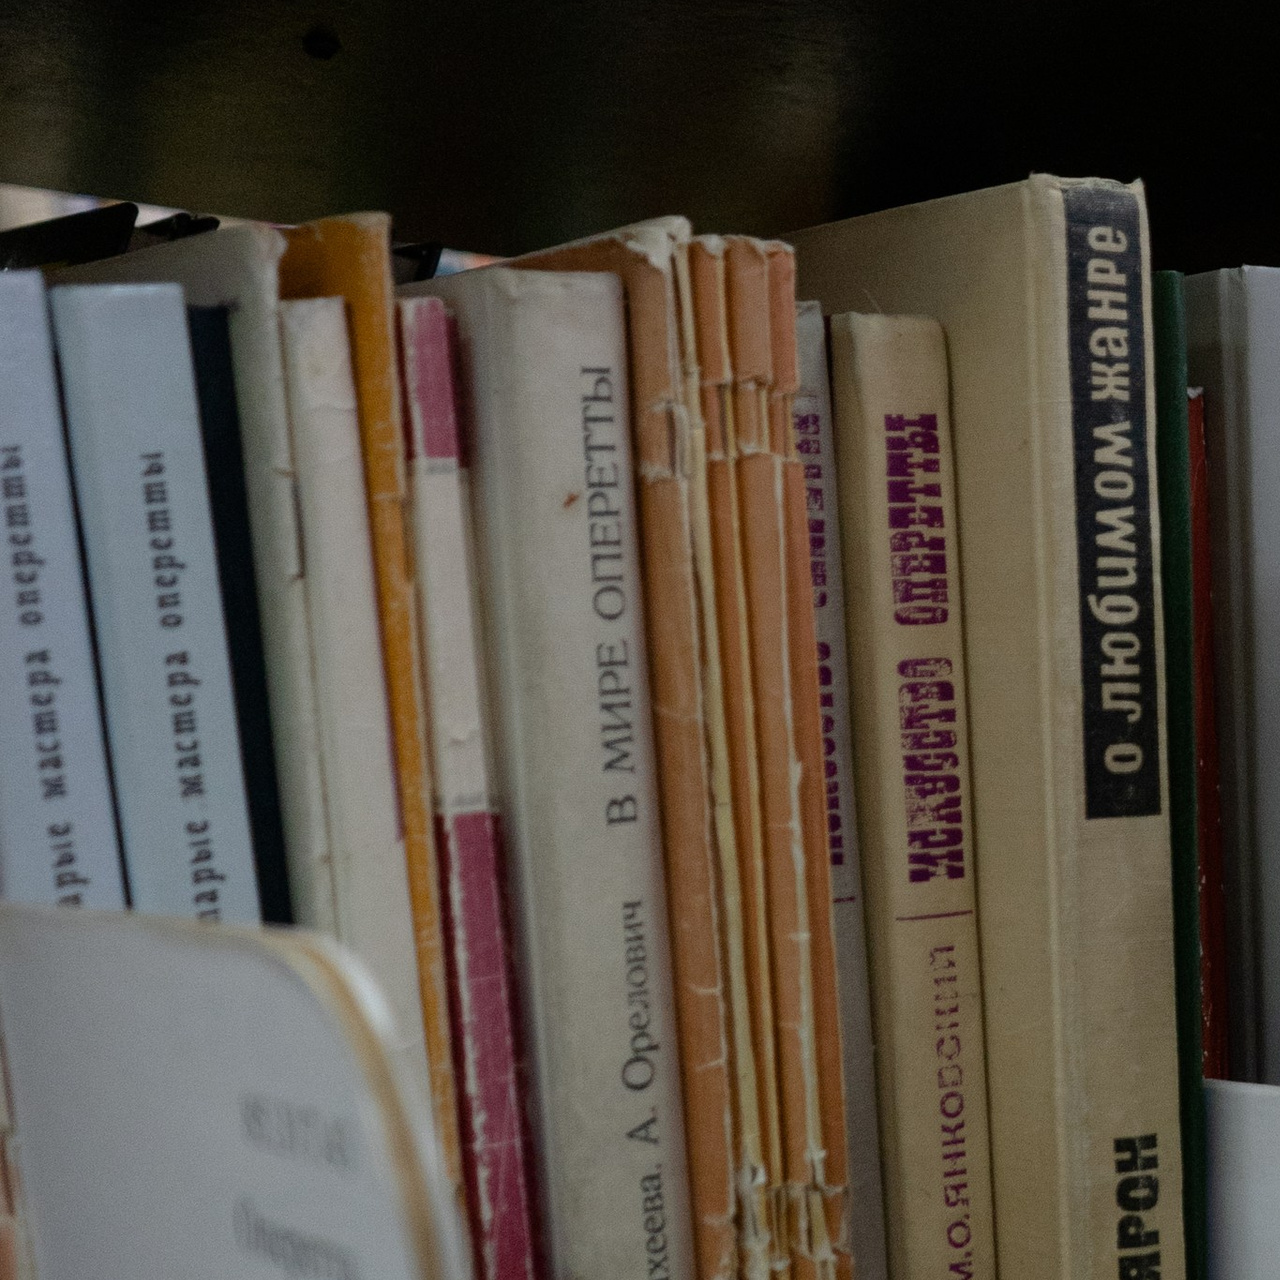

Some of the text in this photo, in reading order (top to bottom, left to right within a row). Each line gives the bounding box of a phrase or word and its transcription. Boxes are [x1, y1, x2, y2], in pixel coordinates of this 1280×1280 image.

[1087, 224, 1130, 403] жанре
[140, 450, 187, 629] оперетты
[580, 366, 639, 826] В МИРЕ ОПЕРЕТТЫ
[884, 413, 966, 884] ИСКУССТВО ОПЕРЕТТЫ
[1088, 420, 1143, 723] любимом
[1, 443, 90, 908] арые мастера оперетты
[165, 650, 203, 800] мастера
[621, 899, 659, 1093] Орелович
